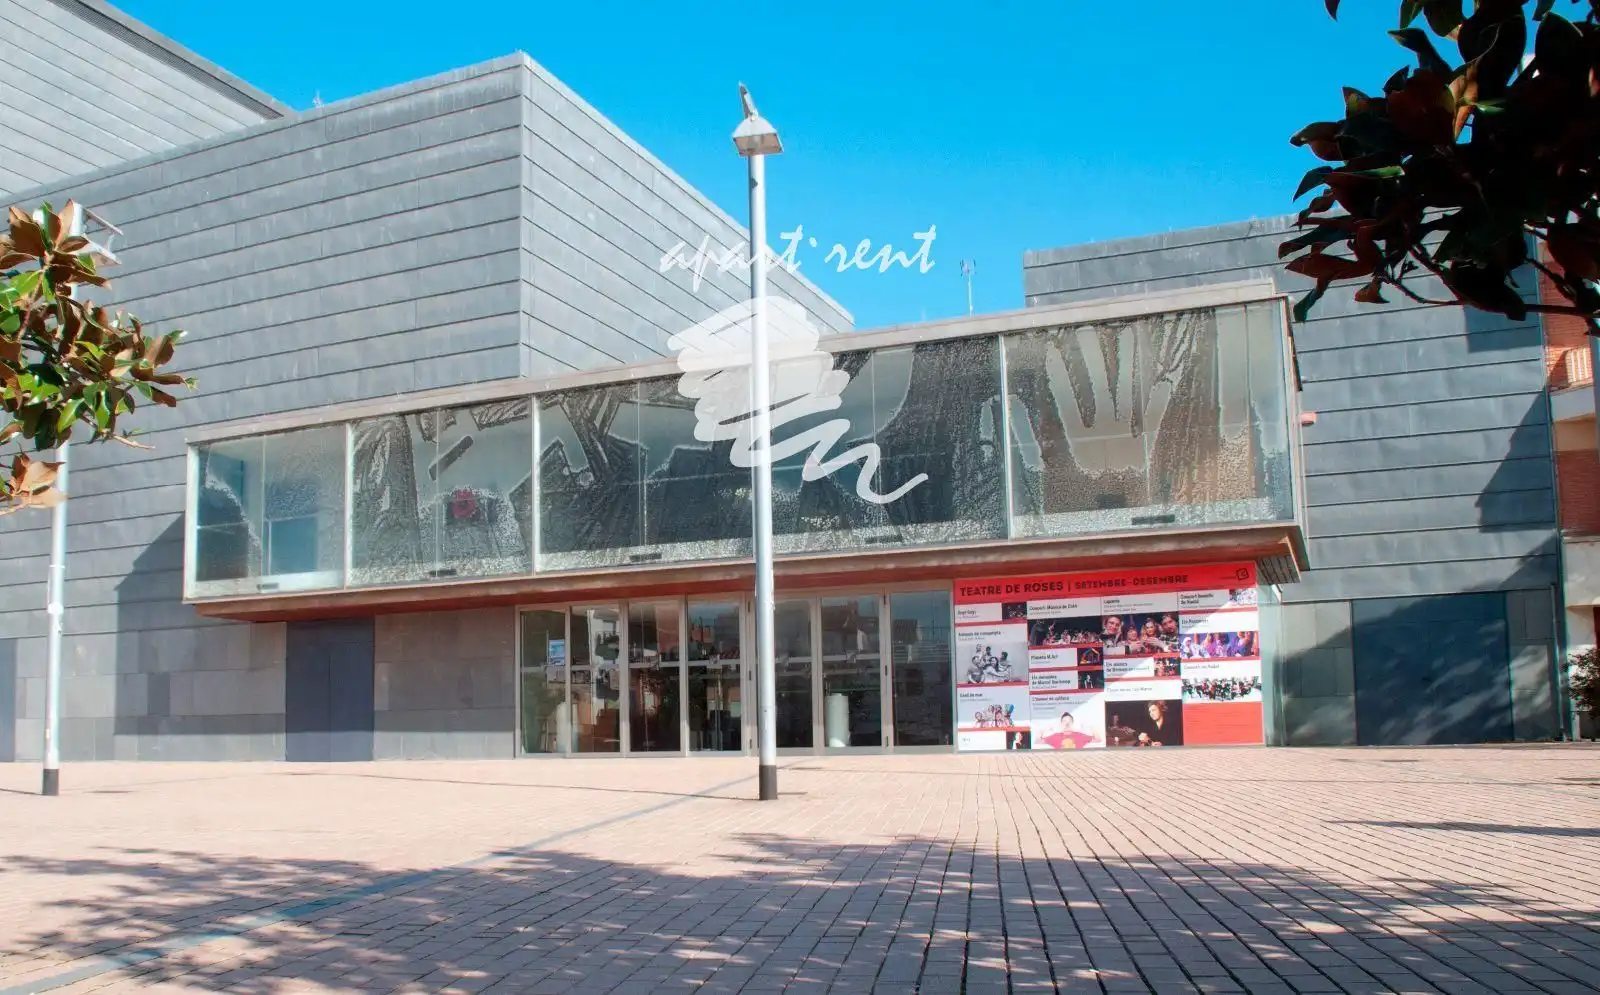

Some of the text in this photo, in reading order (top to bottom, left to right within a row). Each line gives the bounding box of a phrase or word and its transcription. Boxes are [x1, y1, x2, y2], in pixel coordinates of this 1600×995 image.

[960, 585, 1002, 596] TEATRE
[1005, 584, 1020, 594] DE
[1024, 581, 1063, 592] ROSES
